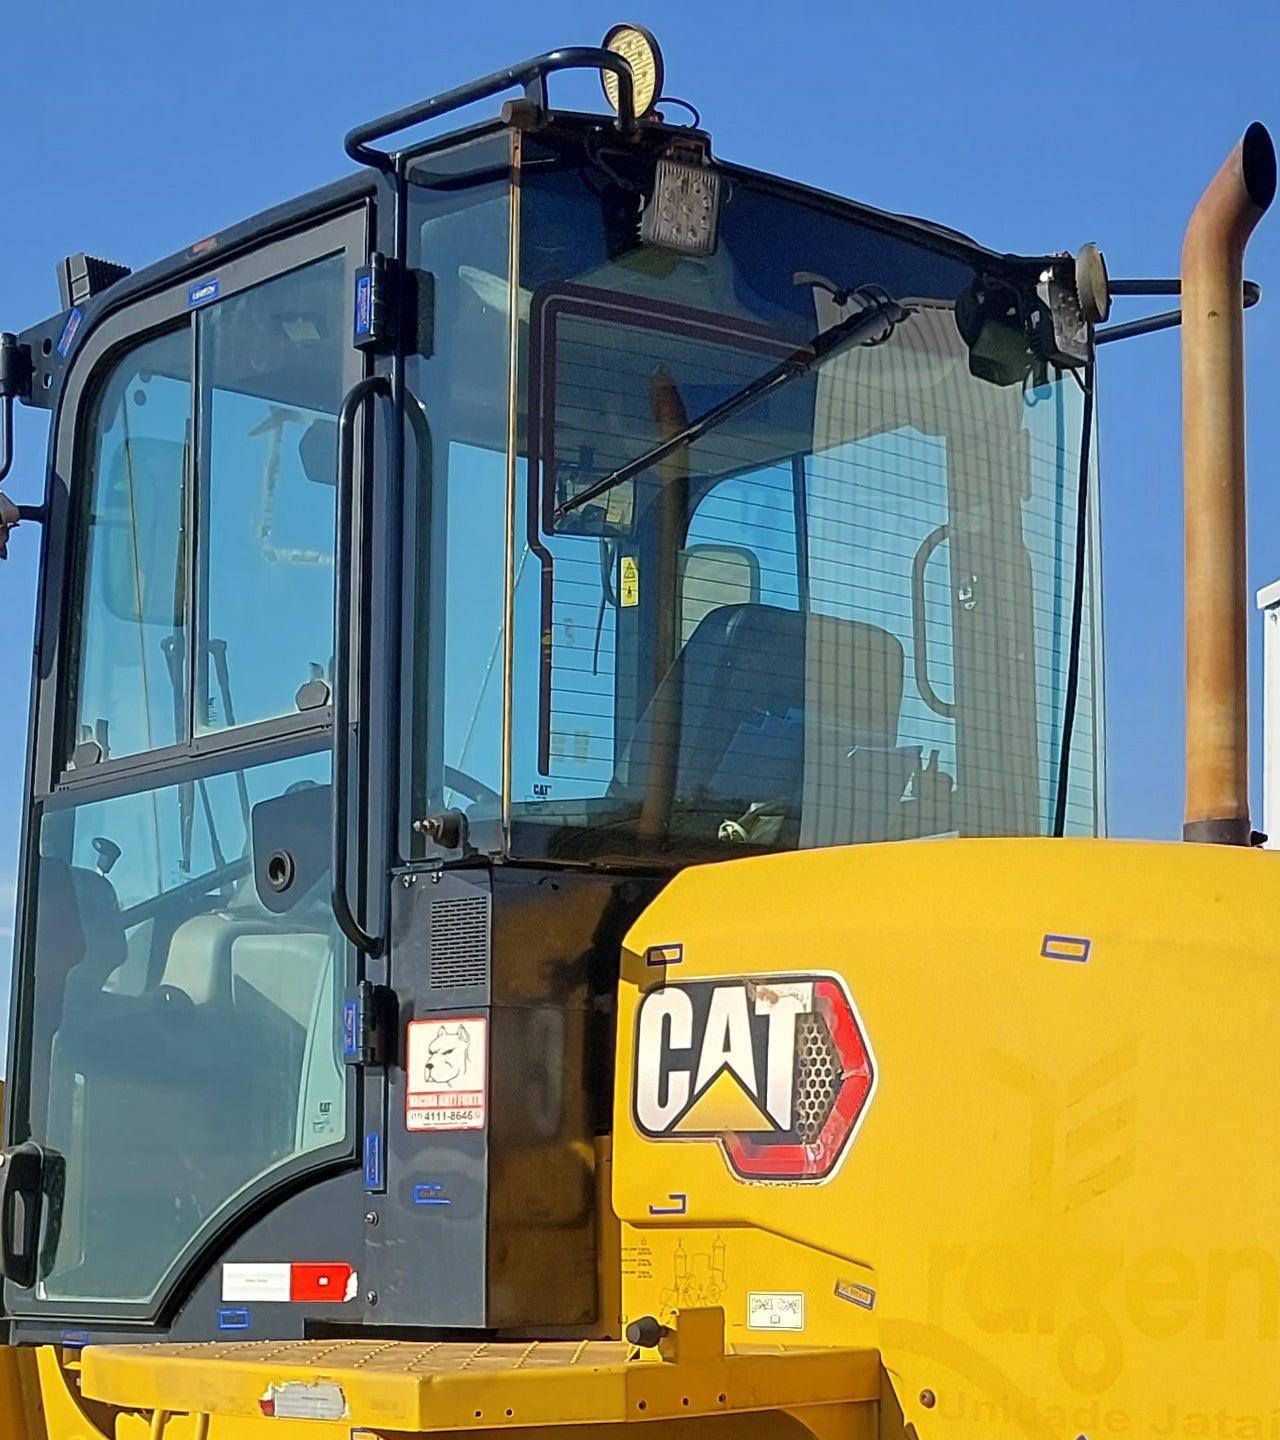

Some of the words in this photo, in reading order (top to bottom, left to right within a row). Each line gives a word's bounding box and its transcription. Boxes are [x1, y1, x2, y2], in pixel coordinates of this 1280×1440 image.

[637, 981, 815, 1133] CAT
[424, 1110, 473, 1121] 4111-8646
[937, 1389, 1131, 1434] Unidade
